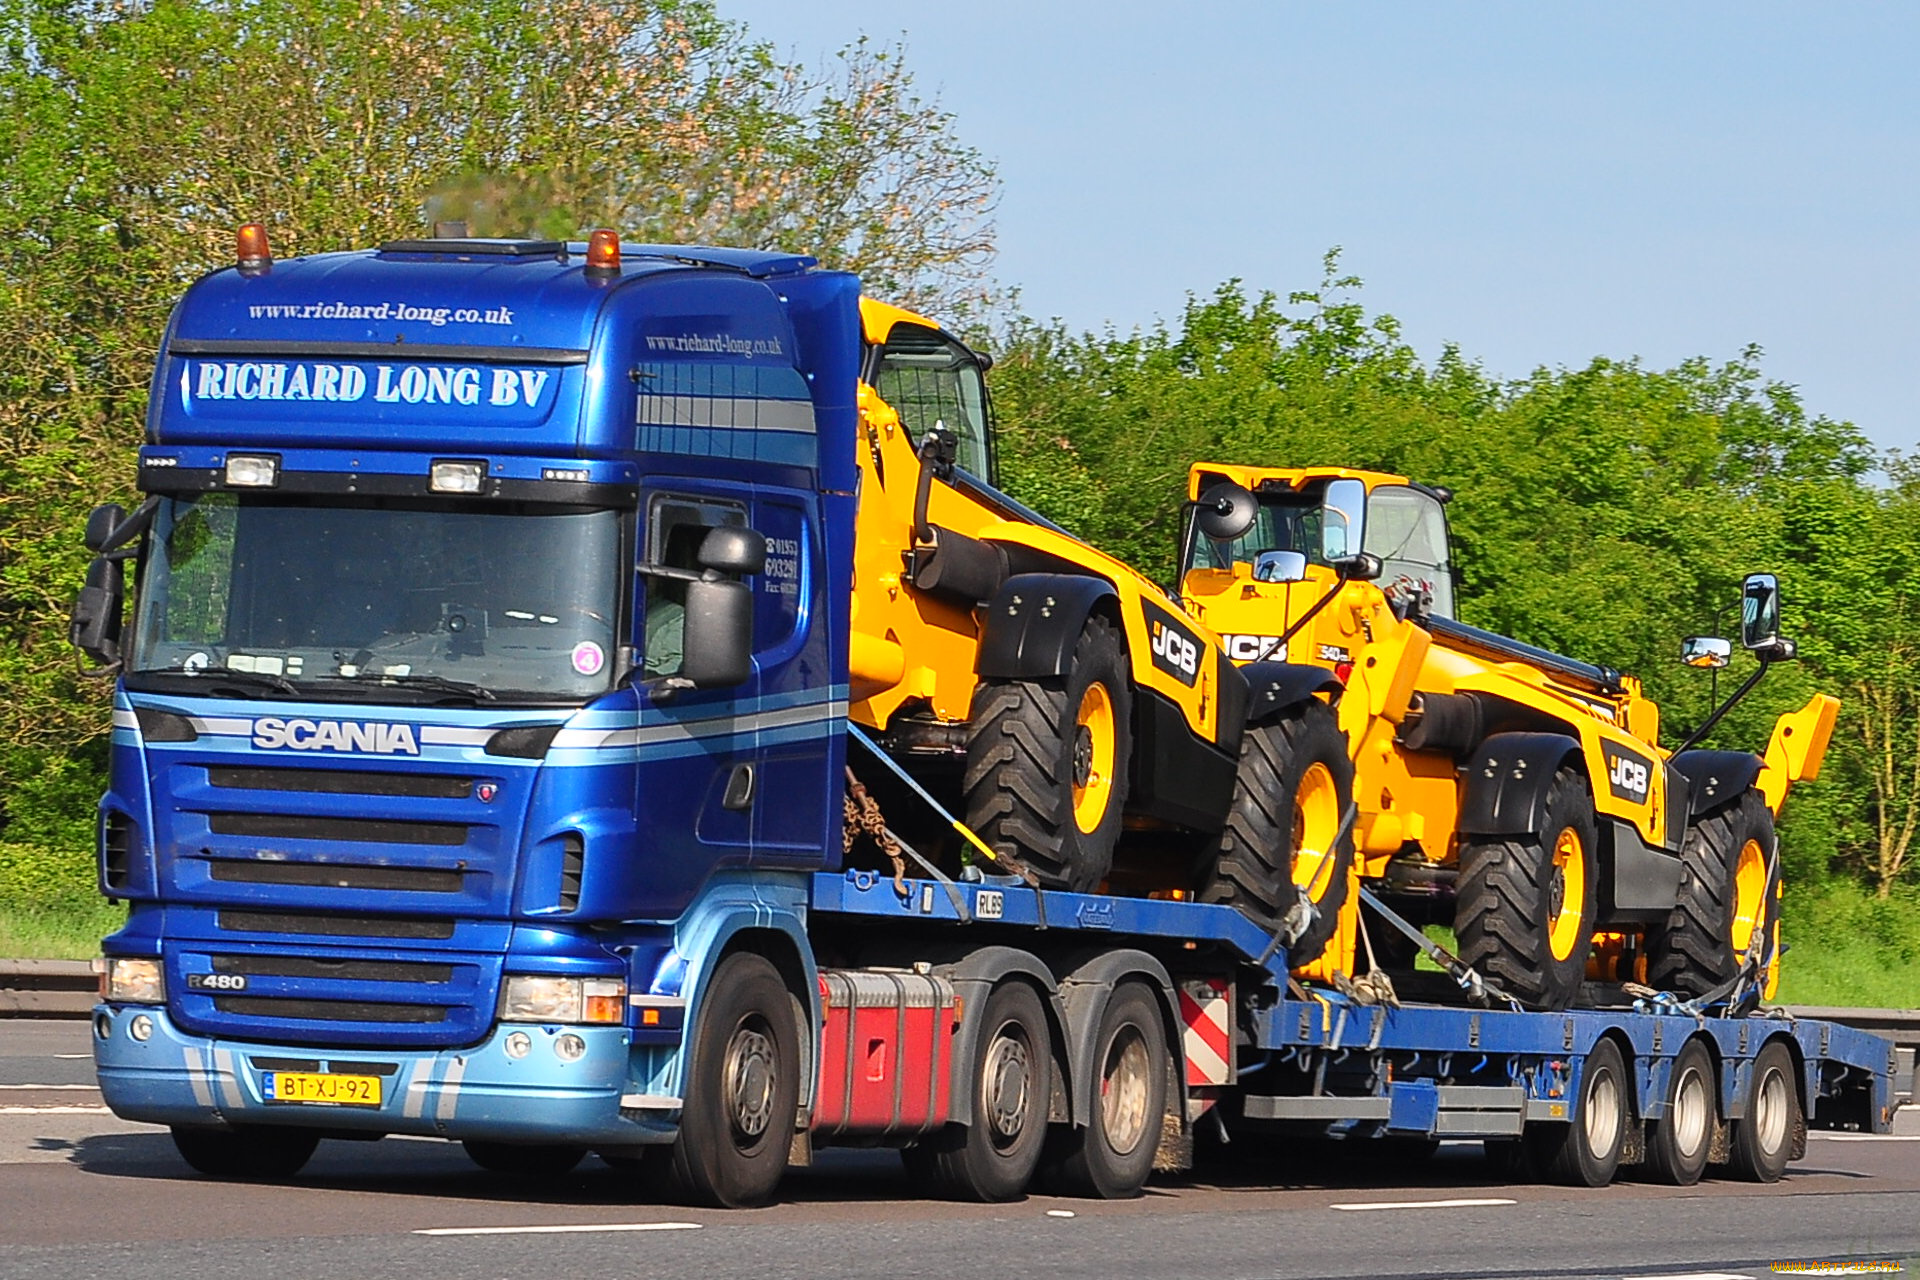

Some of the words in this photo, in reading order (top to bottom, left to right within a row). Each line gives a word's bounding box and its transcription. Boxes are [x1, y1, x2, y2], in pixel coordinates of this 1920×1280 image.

[249, 303, 515, 327] www.richard-long.co.uk
[646, 333, 783, 359] www.richard-long.co.uk
[196, 363, 367, 402] RICHARD
[374, 366, 480, 406] LONG
[489, 370, 549, 408] BV
[1152, 625, 1197, 676] JCB
[252, 717, 419, 755] SCANIA
[1611, 757, 1647, 794] JCB
[202, 975, 245, 989] 480
[284, 1077, 371, 1100] BT-XJ-92
